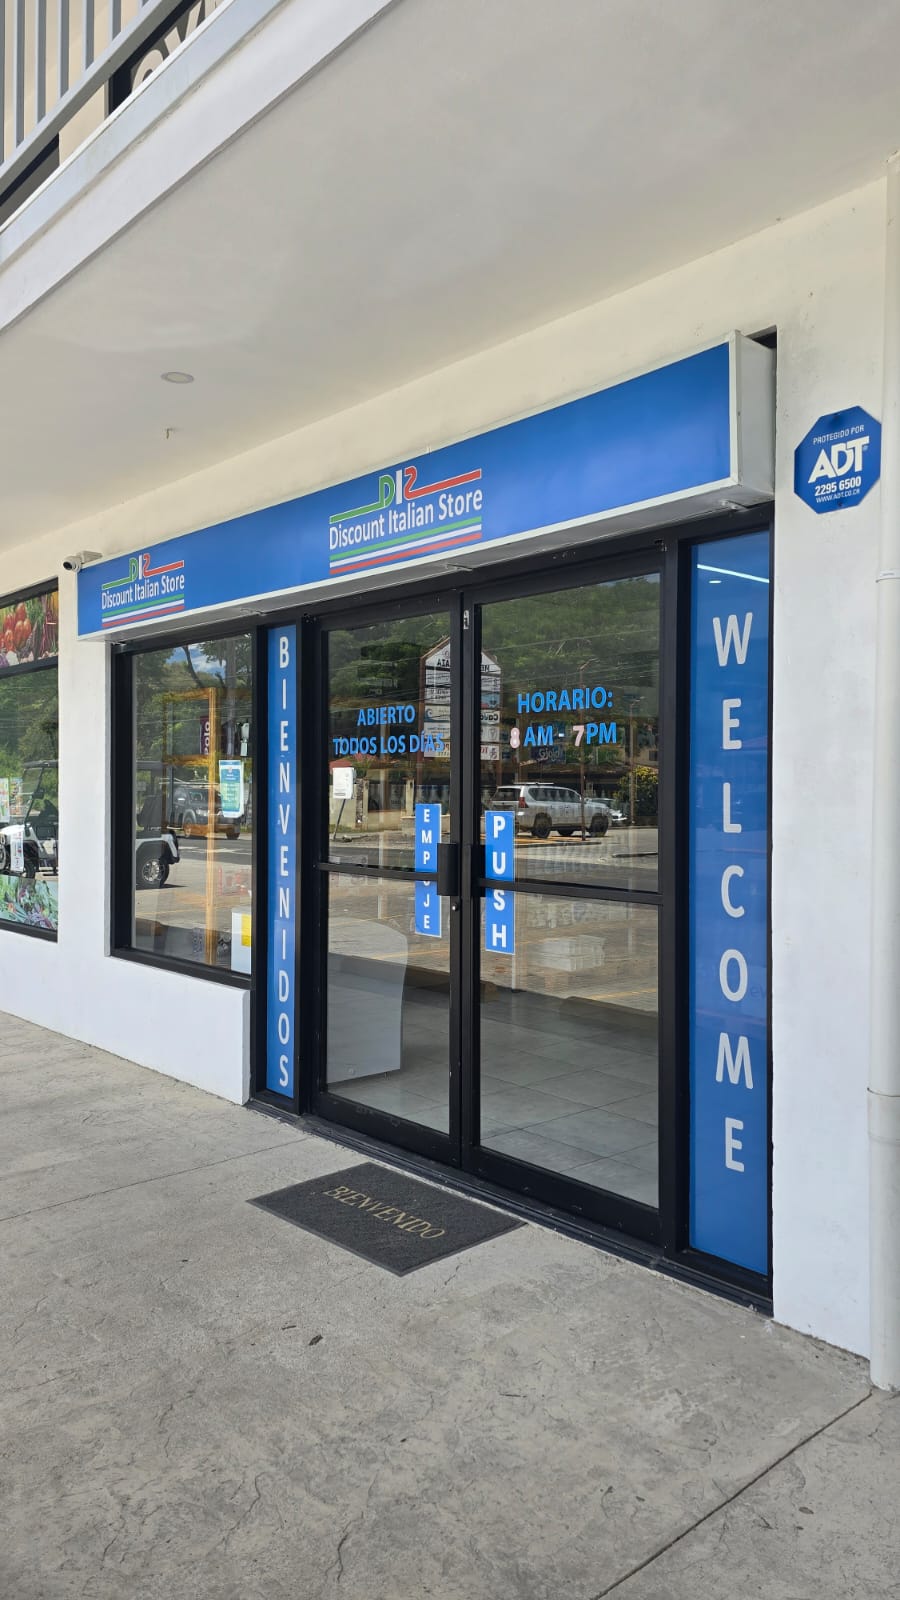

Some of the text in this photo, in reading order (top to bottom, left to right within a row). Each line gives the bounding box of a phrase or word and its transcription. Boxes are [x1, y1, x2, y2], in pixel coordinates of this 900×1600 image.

[813, 424, 865, 445] PROTEGIDO POR
[808, 436, 870, 484] ADT
[815, 476, 862, 497] 2295 6500
[816, 488, 860, 503] WWW.ADT.CO.CR
[329, 488, 483, 550] Discount Italian Store
[101, 574, 185, 610] Discount Italian Store
[357, 704, 416, 726] ABIERTO
[517, 686, 613, 714] HORARIO:
[333, 736, 378, 756] TODOS
[380, 734, 406, 754] LOS
[409, 729, 446, 753] DÍAS
[510, 727, 520, 749] 8
[523, 725, 554, 747] AM
[278, 636, 291, 1088] BIENVENIDOS
[492, 815, 507, 948] PUSH
[712, 611, 753, 1172] WELCOME
[321, 1185, 446, 1240] BIENVENIDO
